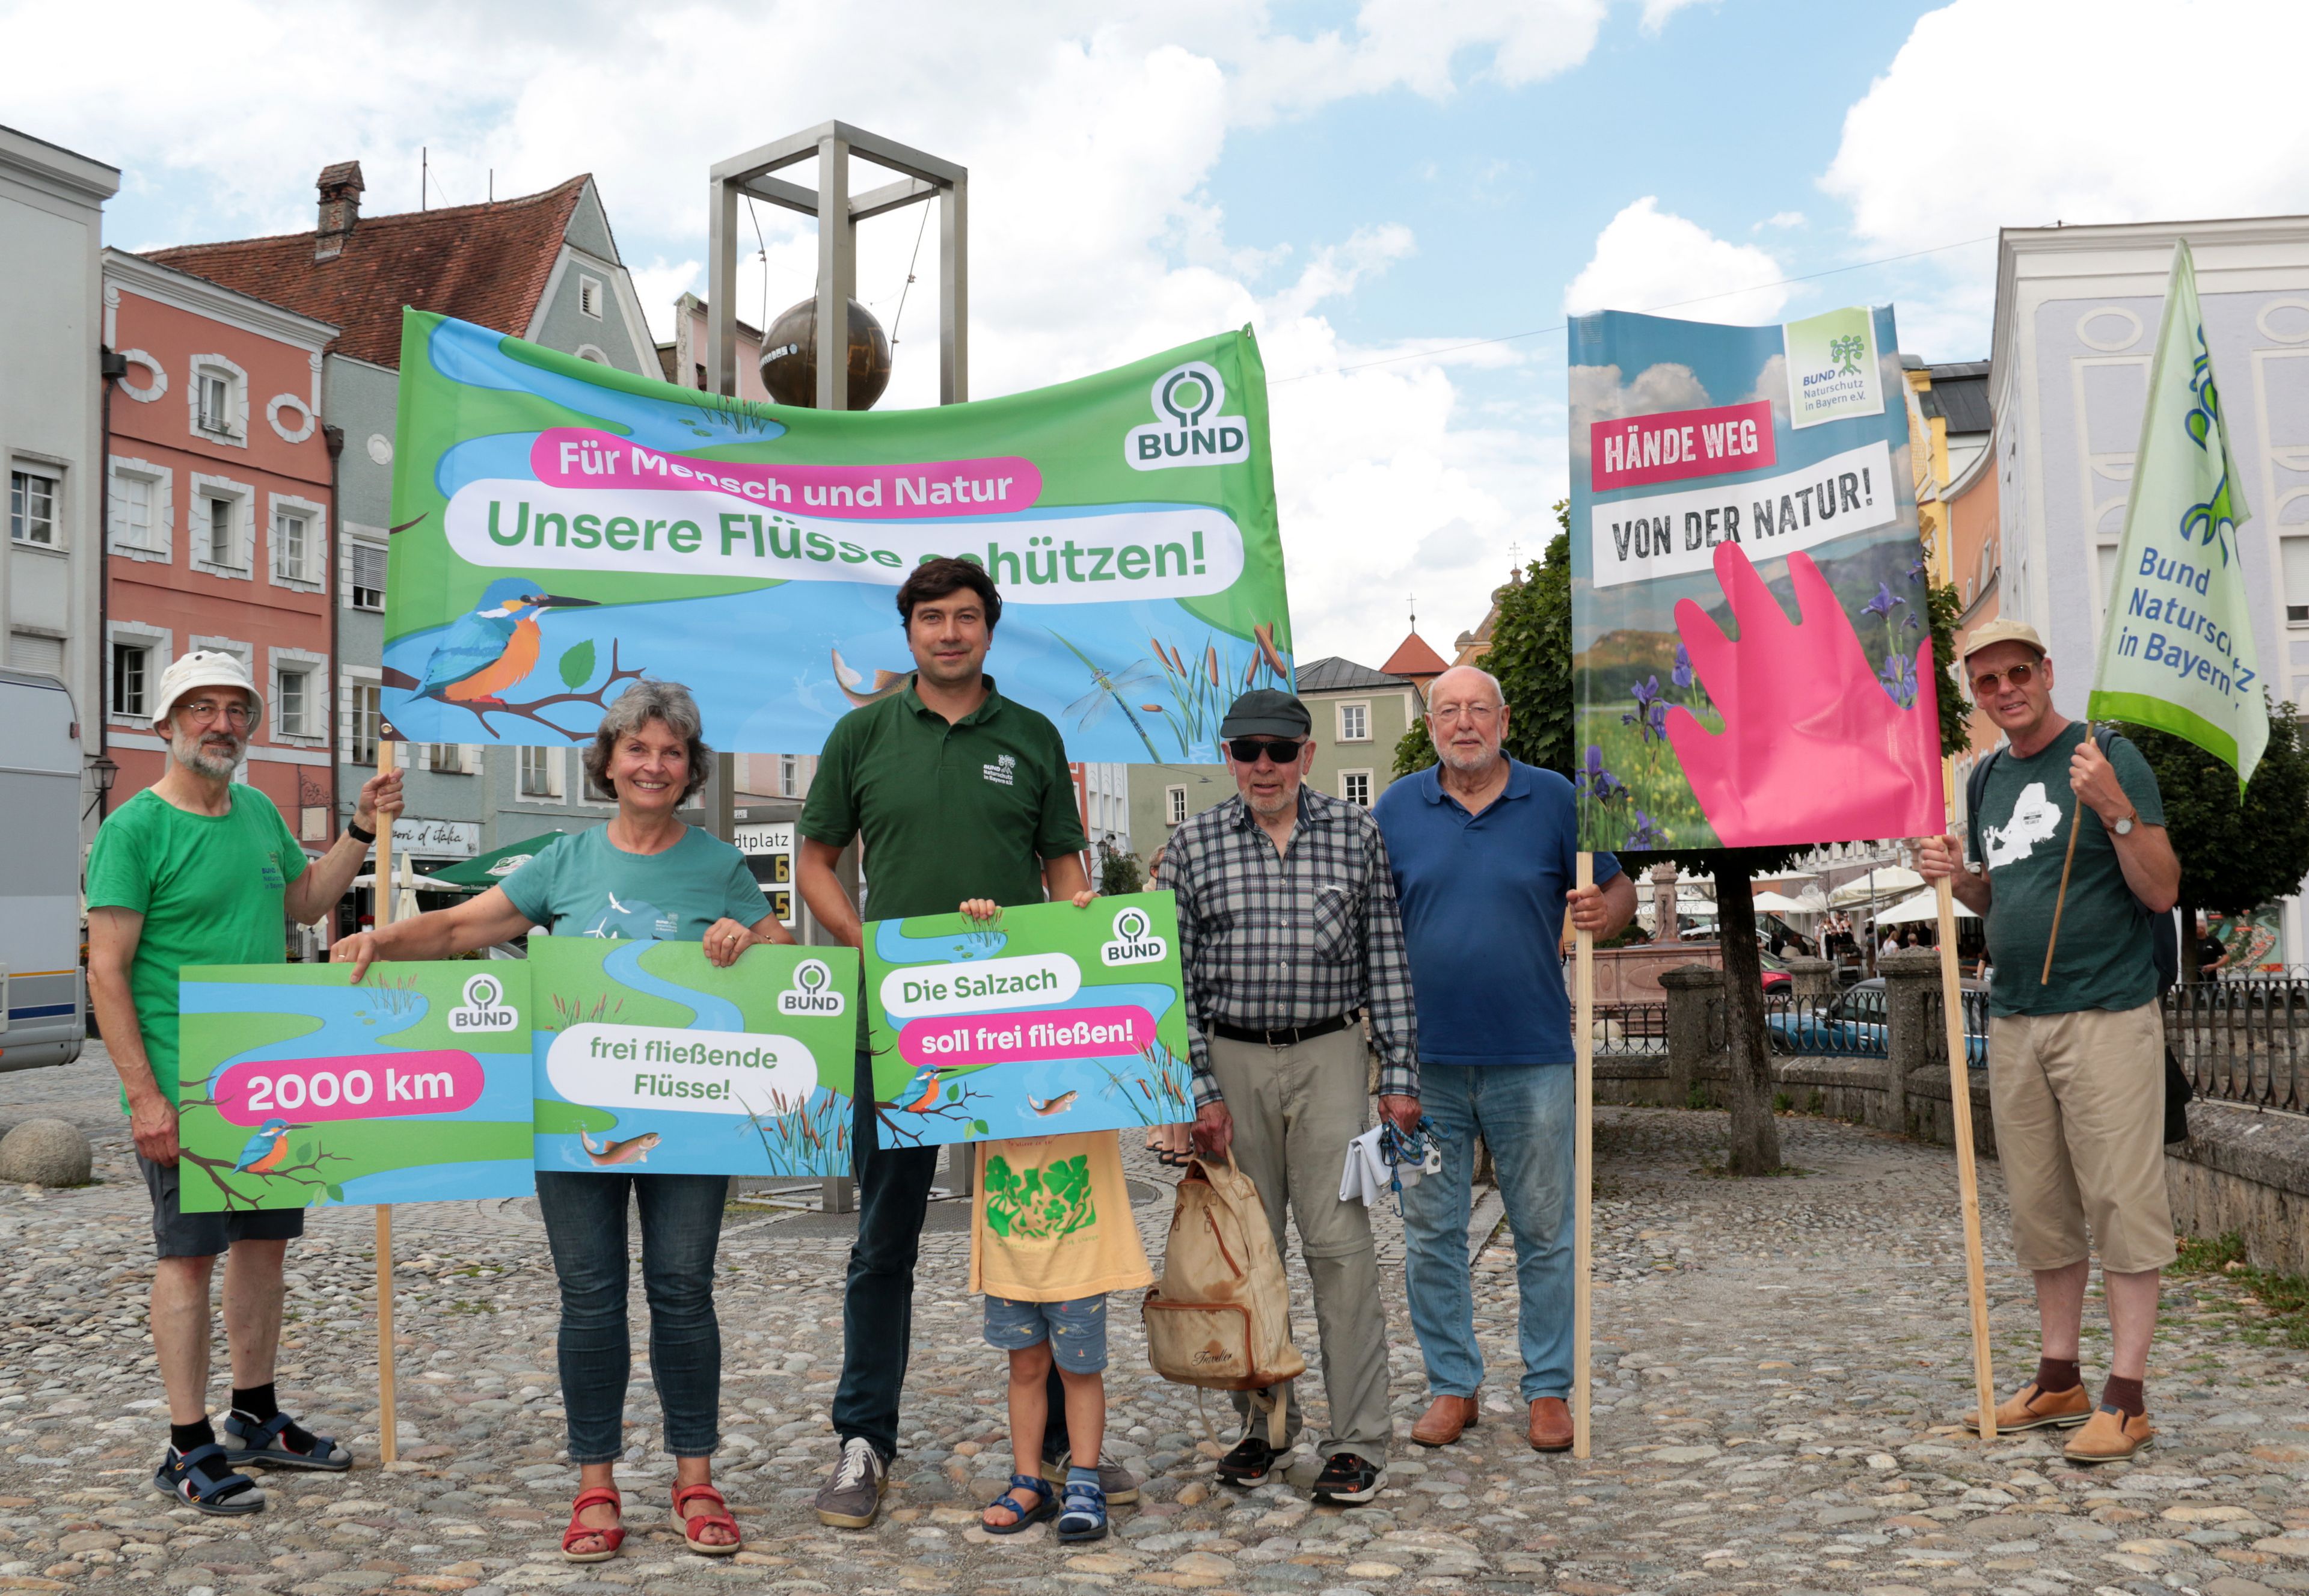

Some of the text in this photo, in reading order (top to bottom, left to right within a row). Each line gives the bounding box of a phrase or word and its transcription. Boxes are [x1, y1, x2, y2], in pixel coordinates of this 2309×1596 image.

[1803, 369, 1835, 386] BUND
[1804, 379, 1863, 399] Naturschutz
[1805, 391, 1866, 411] in Bayern e.V.
[1138, 426, 1244, 461] BUND
[1604, 419, 1758, 473] HÄNDE WEG
[559, 440, 1013, 508] Für Mensch und Natur
[1612, 467, 1872, 562] VON DER NATUR!
[488, 500, 1207, 586] Unsere Flüsse hützen!
[2139, 547, 2210, 597] Bund
[2117, 626, 2231, 696] in Bayern
[434, 826, 464, 845] italia
[734, 832, 789, 852] dtplatz
[775, 855, 789, 883] 6
[776, 892, 789, 920] 5
[1108, 942, 1161, 960] BUND
[903, 968, 1058, 1003] Die Salzach
[784, 995, 839, 1010] BUND
[455, 1012, 512, 1027] BUND
[921, 1019, 1133, 1054] soll frei fließen!
[590, 1036, 777, 1069] frei fließende
[247, 1068, 454, 1111] 2000 km
[634, 1073, 731, 1100] Flüsse!
[1191, 1348, 1233, 1366] Traveller
